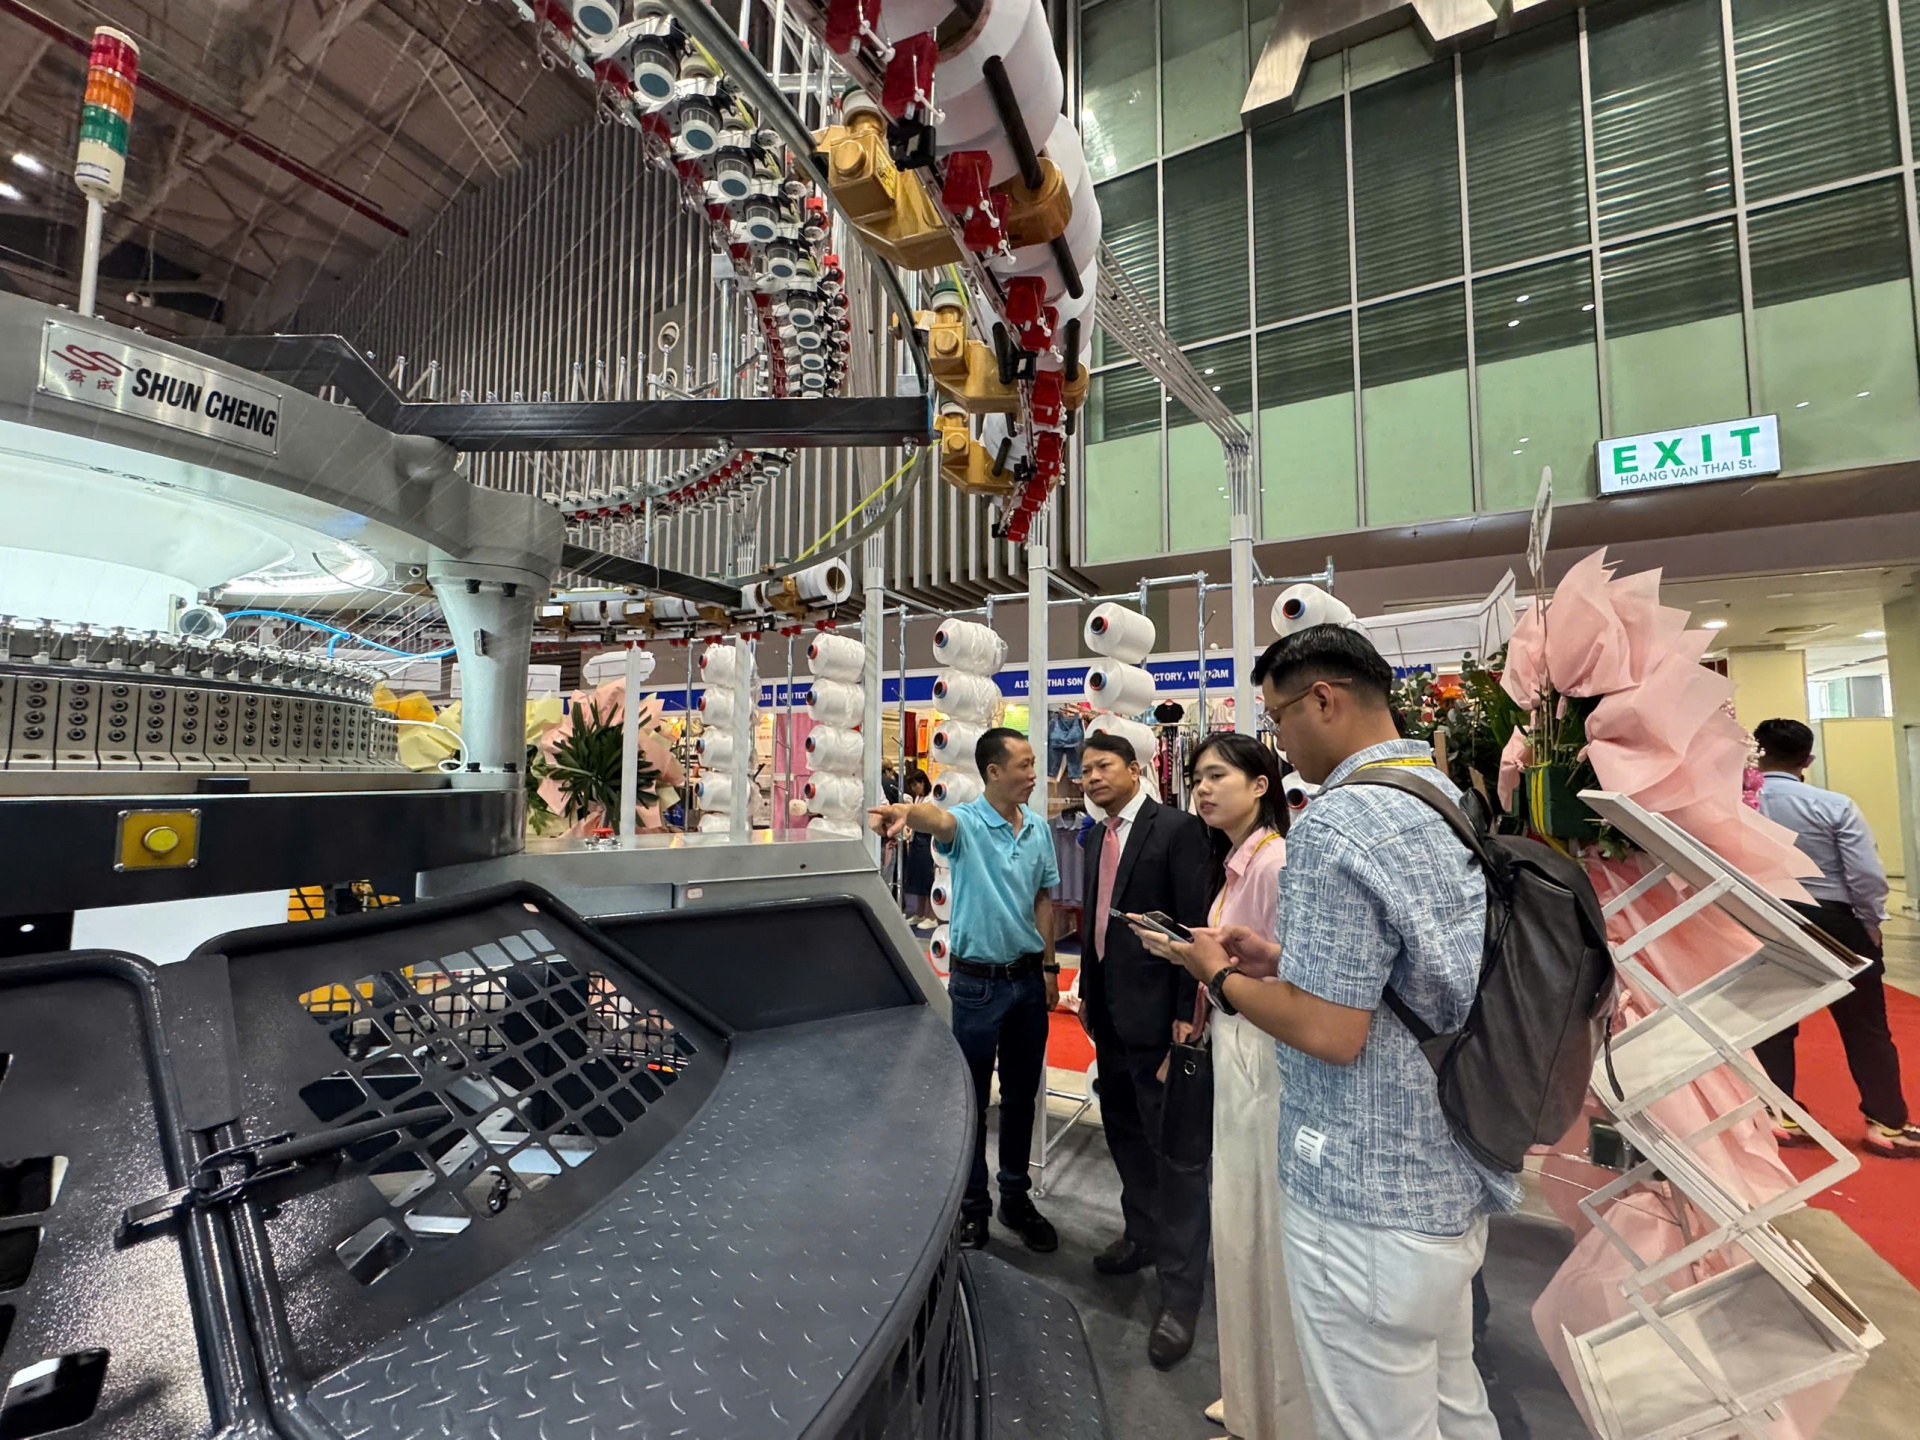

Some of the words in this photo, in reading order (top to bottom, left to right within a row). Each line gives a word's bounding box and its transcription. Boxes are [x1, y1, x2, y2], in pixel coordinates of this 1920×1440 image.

[132, 368, 202, 412] SHUN
[205, 391, 278, 437] CHENG
[1612, 426, 1761, 475] EXIT
[1620, 470, 1668, 486] HOANG
[1671, 466, 1699, 478] VAN
[1702, 461, 1734, 475] THAI
[1738, 459, 1757, 470] St.
[1014, 680, 1029, 689] A13
[1047, 679, 1065, 687] THAI
[1067, 677, 1083, 686] SON
[1153, 671, 1186, 682] CTORY,
